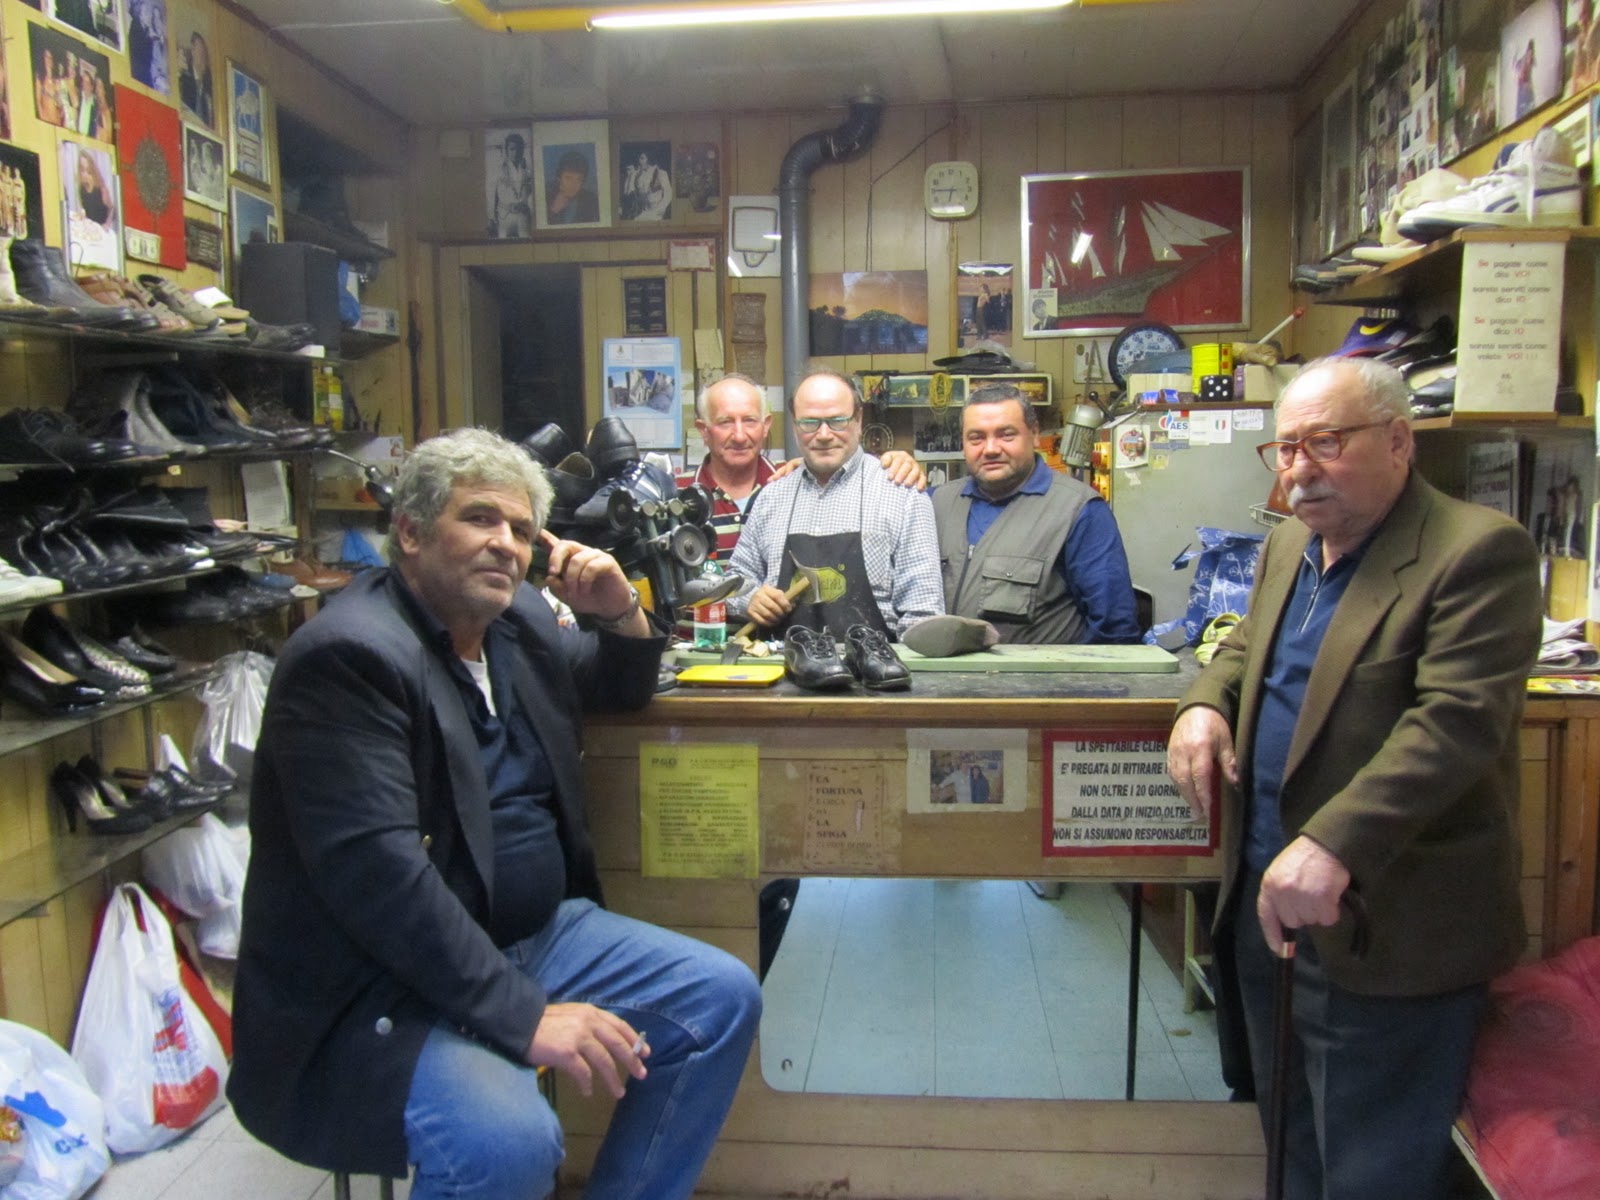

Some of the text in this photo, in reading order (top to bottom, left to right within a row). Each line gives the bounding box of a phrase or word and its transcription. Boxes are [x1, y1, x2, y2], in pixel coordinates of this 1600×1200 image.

[1170, 422, 1188, 430] AES
[1075, 741, 1168, 753] LA SPETTABILE CLIEN
[1071, 763, 1108, 775] PREGATA
[1112, 763, 1120, 775] DI
[1123, 763, 1163, 774] RITIRARE
[1080, 785, 1099, 796] NON
[1101, 785, 1128, 796] OLTRE
[1136, 785, 1146, 796] 20
[1072, 806, 1098, 818] DALLA
[1101, 806, 1121, 818] DATA
[1124, 806, 1133, 818] DI
[1053, 828, 1071, 840] NON
[1084, 828, 1133, 840] ASSUMONO
